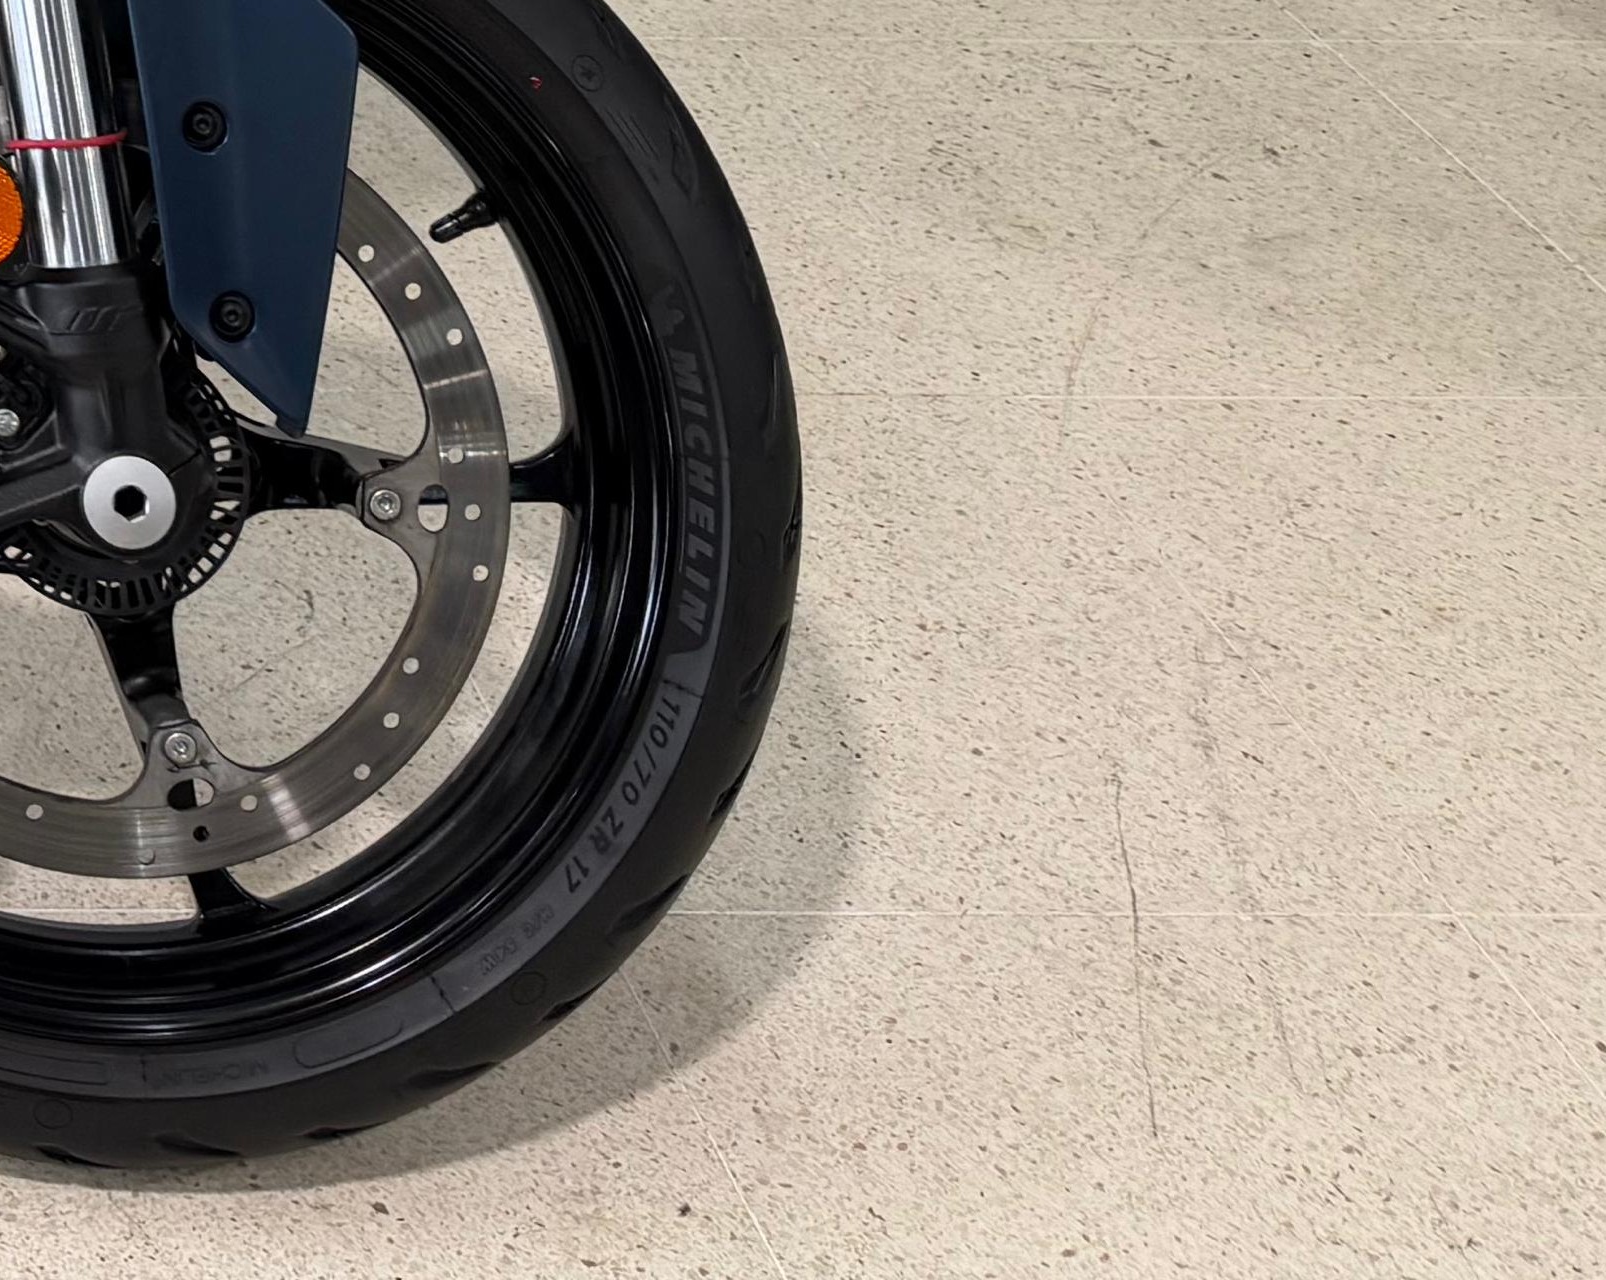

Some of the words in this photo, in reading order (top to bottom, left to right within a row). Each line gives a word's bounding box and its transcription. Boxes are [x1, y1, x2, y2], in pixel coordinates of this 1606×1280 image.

[668, 347, 718, 644] MICHELIN
[622, 697, 683, 806] 110/70
[589, 811, 624, 858] ZR
[564, 864, 591, 895] 17
